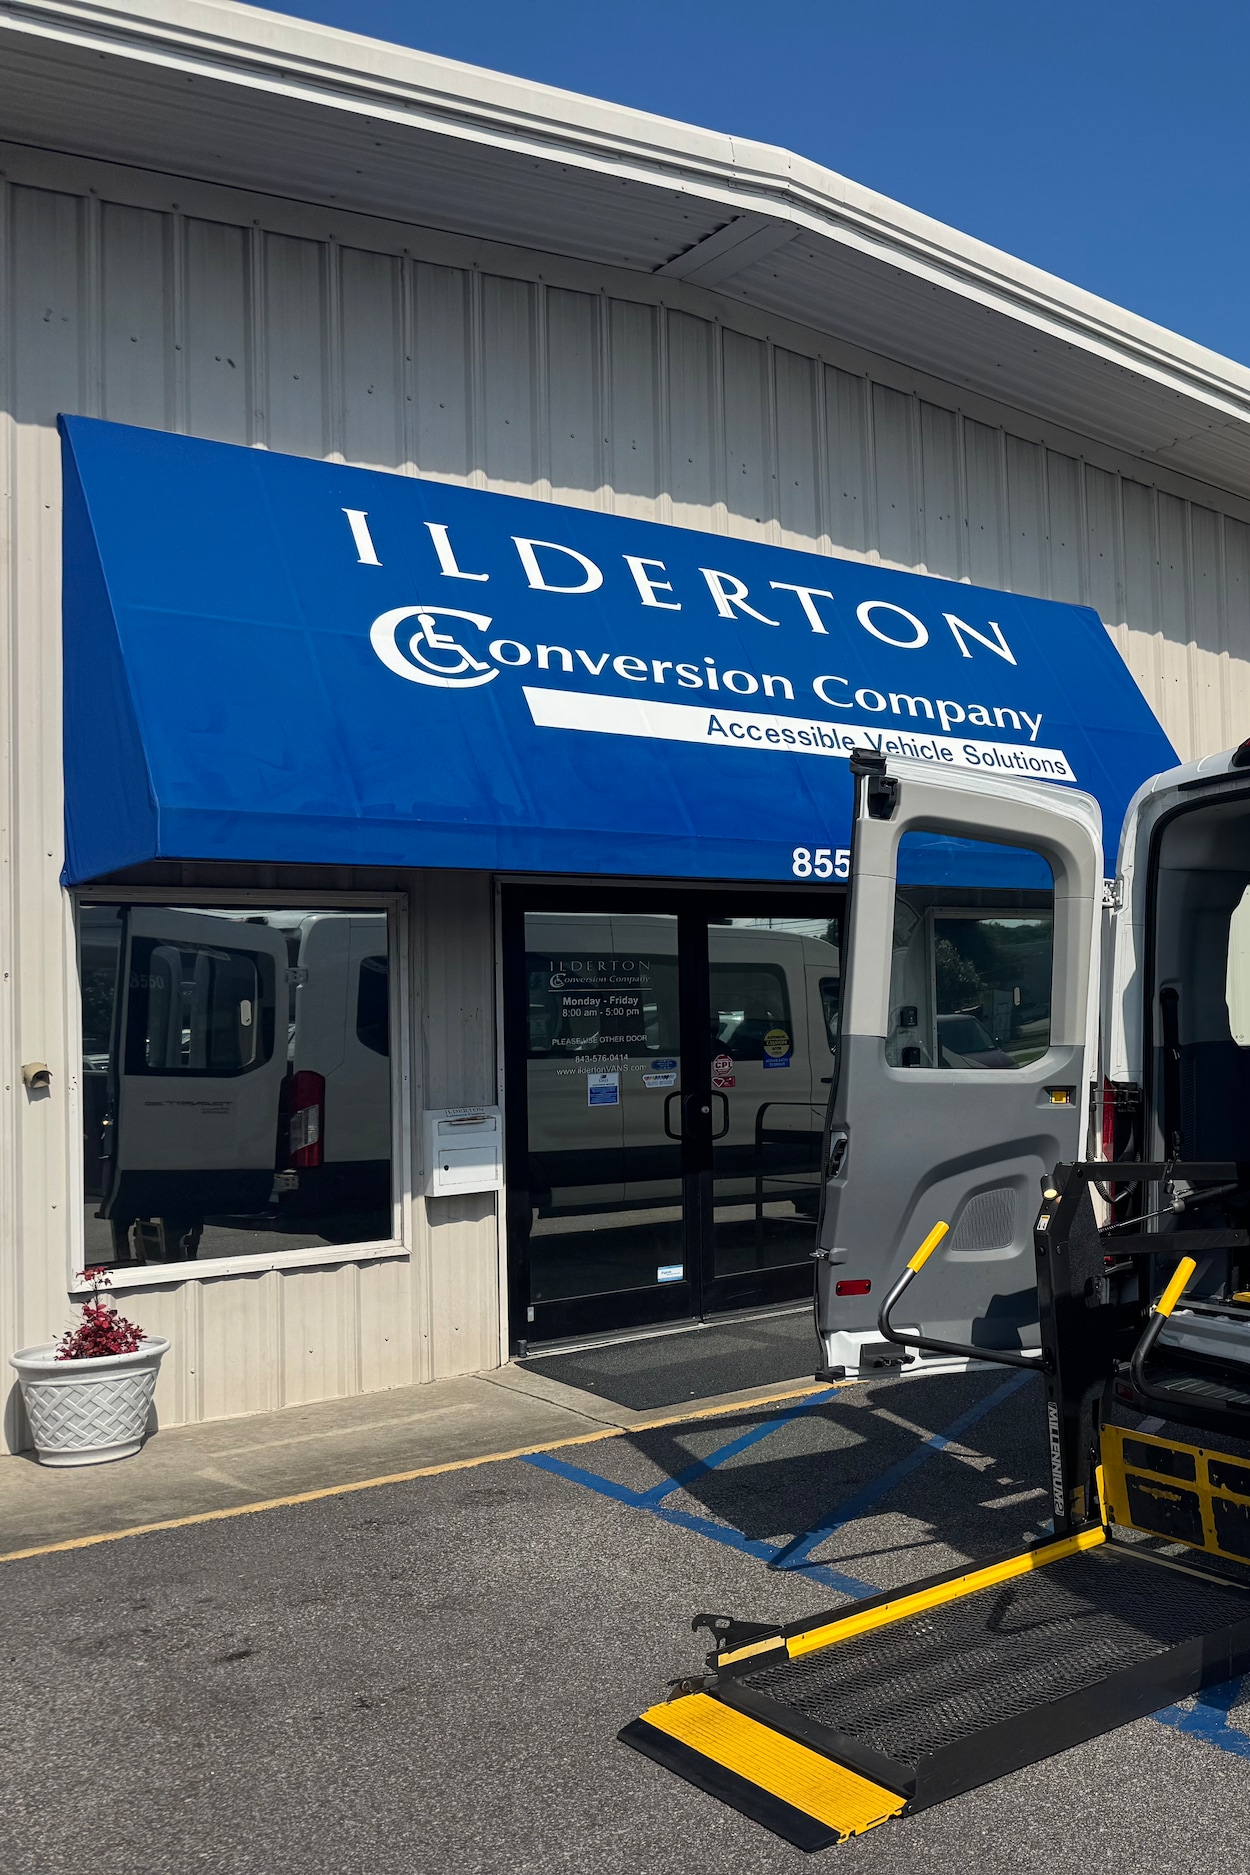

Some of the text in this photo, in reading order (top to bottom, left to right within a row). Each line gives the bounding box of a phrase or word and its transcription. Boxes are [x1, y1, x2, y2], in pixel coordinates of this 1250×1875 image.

[341, 508, 1018, 666] ILDERTON
[369, 605, 1043, 742] Conversion Company
[706, 713, 1067, 775] Accessible Vehicle Solutions
[549, 960, 651, 972] ILDERTON
[549, 973, 651, 988] Conversion Company
[562, 996, 600, 1007] Monday
[609, 996, 639, 1006] Friday
[562, 1008, 582, 1017] 8:00
[605, 1008, 625, 1016] 5:00
[626, 1009, 640, 1017] pm
[552, 1038, 581, 1046] PLEASE
[599, 1035, 625, 1043] OTHER
[625, 1034, 648, 1042] DOOR
[575, 1054, 629, 1063] 843-576-0414
[715, 1061, 731, 1070] CPI
